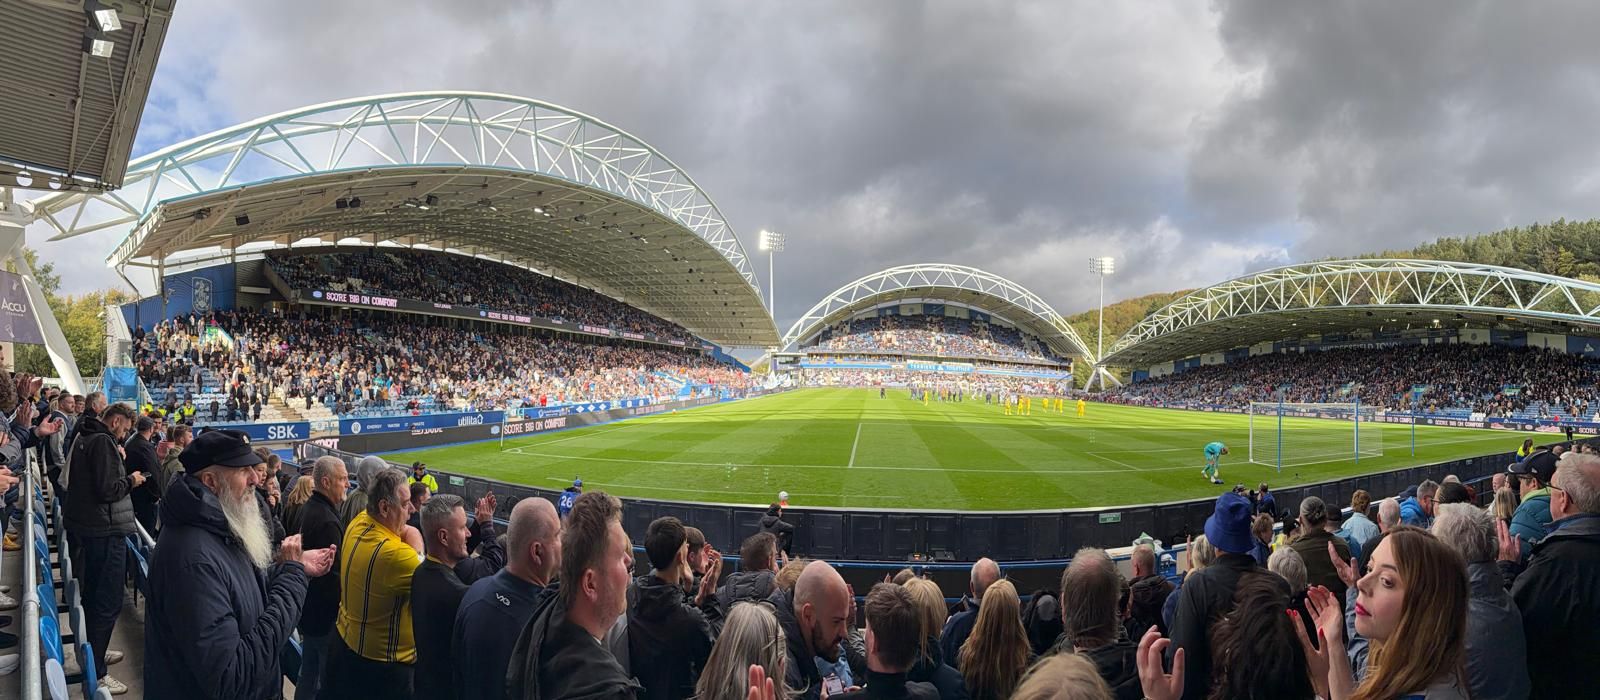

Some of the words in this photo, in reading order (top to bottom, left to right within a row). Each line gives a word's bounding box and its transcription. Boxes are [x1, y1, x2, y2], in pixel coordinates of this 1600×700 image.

[326, 292, 347, 302] SCORE
[372, 296, 398, 308] COMFORT
[458, 415, 478, 426] utilita
[504, 423, 524, 434] SCORE
[544, 417, 566, 429] COMFORT
[1578, 426, 1597, 434] SCORE
[560, 496, 572, 508] 26
